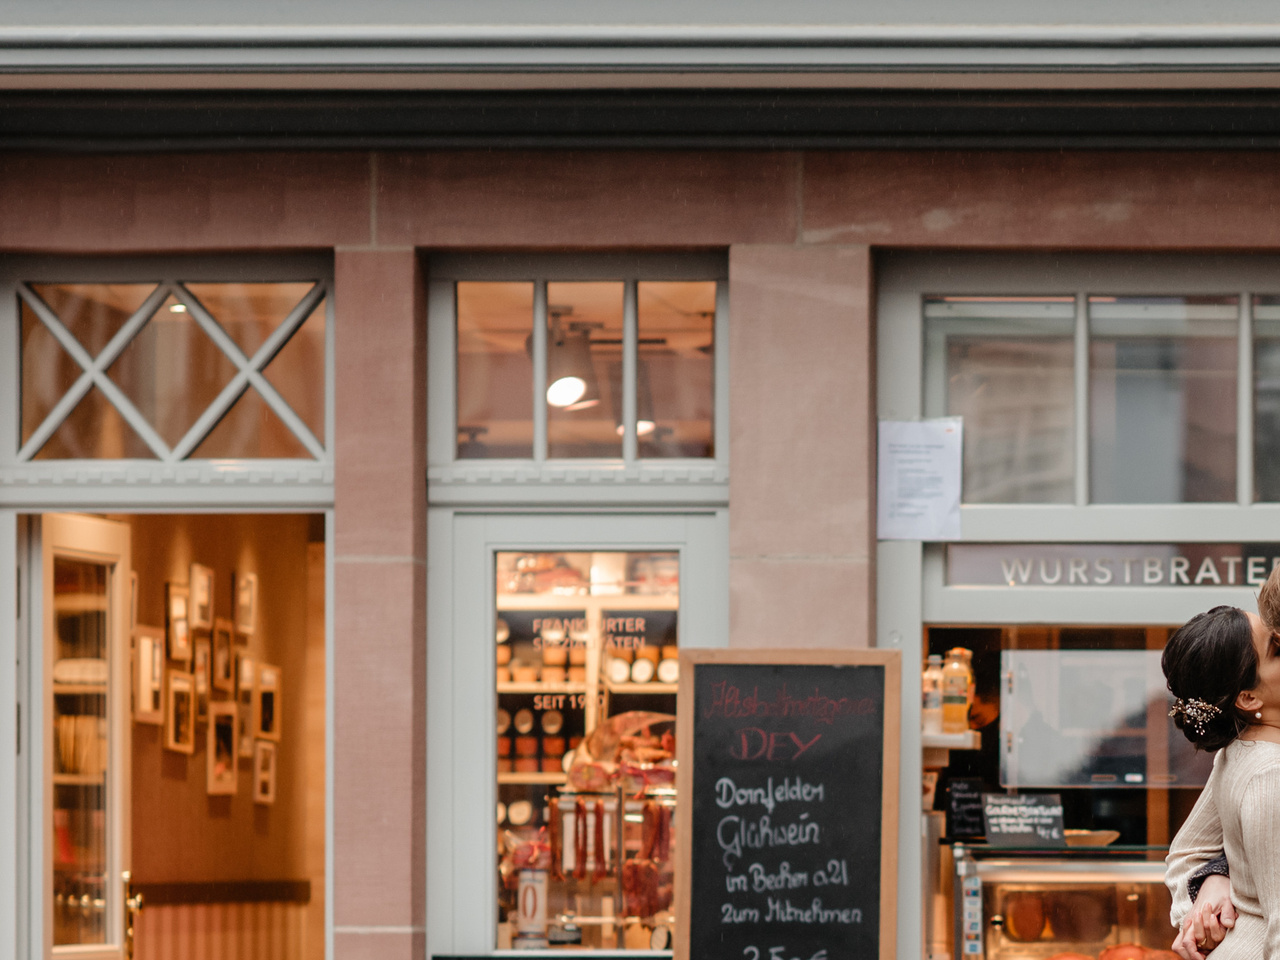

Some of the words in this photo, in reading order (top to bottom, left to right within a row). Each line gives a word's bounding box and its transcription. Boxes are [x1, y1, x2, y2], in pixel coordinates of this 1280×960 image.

[533, 617, 646, 633] FRANKRTER
[533, 695, 566, 710] SEIT
[569, 695, 605, 709] 190
[730, 727, 822, 760] DEY
[715, 777, 824, 813] Dornfelder
[717, 812, 820, 871] Glühwein
[726, 875, 748, 892] im
[748, 862, 808, 893] Becher
[765, 897, 861, 923] Mitnehmen
